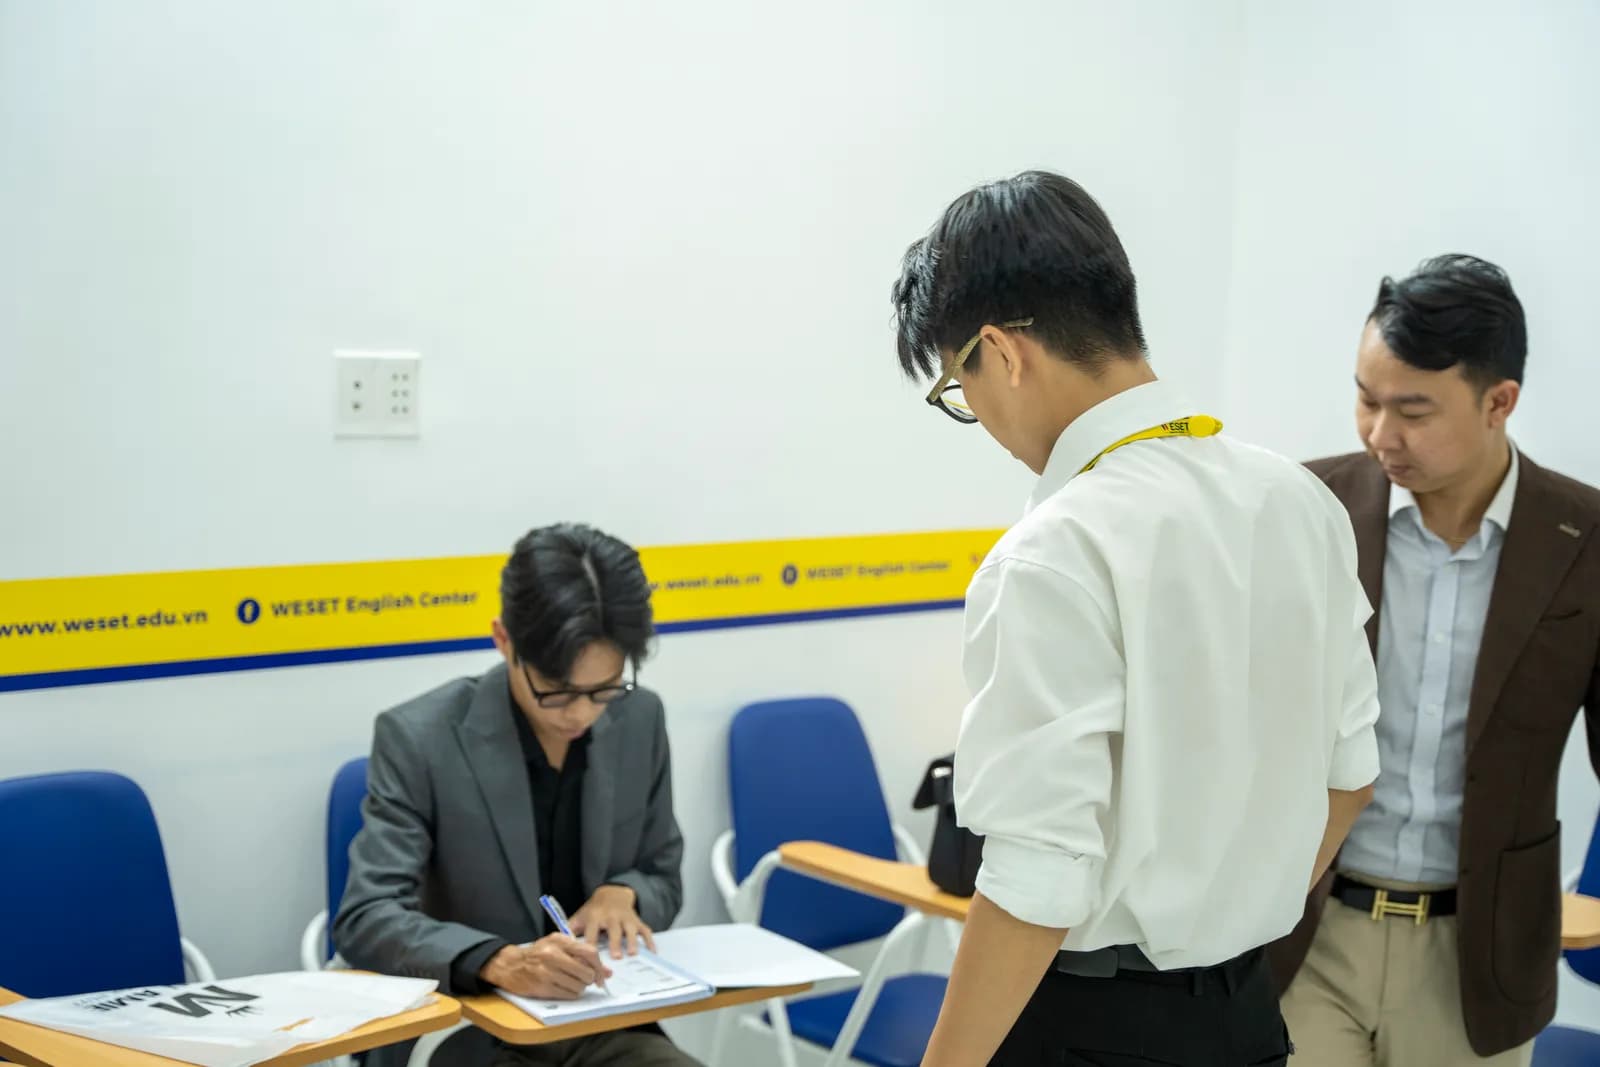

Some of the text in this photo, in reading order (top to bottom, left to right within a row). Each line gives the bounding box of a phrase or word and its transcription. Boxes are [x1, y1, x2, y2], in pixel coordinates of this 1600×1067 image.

[270, 590, 478, 617] WESET English Center
[0, 609, 208, 637] www.weset.edu.vn
